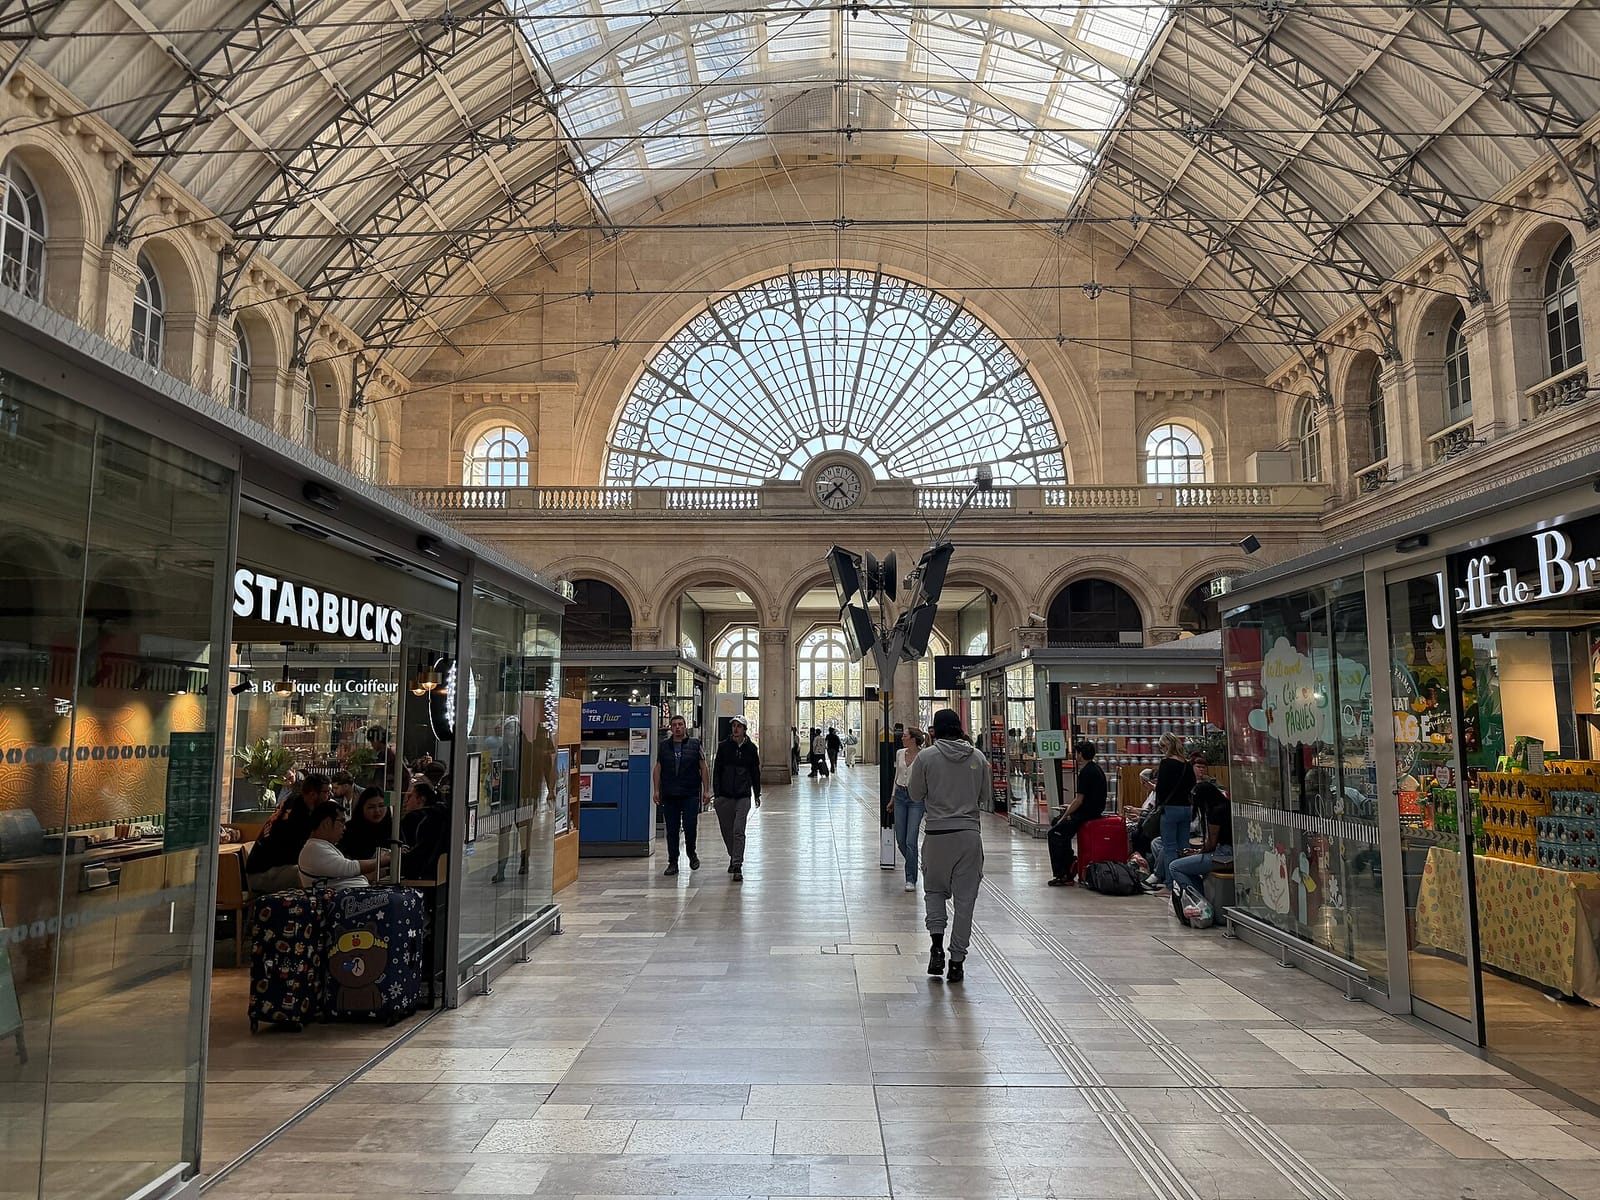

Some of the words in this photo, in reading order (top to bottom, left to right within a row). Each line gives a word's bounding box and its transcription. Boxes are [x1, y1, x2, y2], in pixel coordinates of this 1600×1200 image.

[1431, 555, 1498, 629] Jeff
[1499, 570, 1529, 605] de
[1532, 530, 1600, 599] Br
[233, 569, 402, 645] STARBUCKS
[263, 679, 321, 697] Boique
[325, 680, 341, 693] du
[345, 679, 398, 693] Coiffeur
[601, 713, 622, 724] fluo
[1041, 741, 1061, 752] BIO
